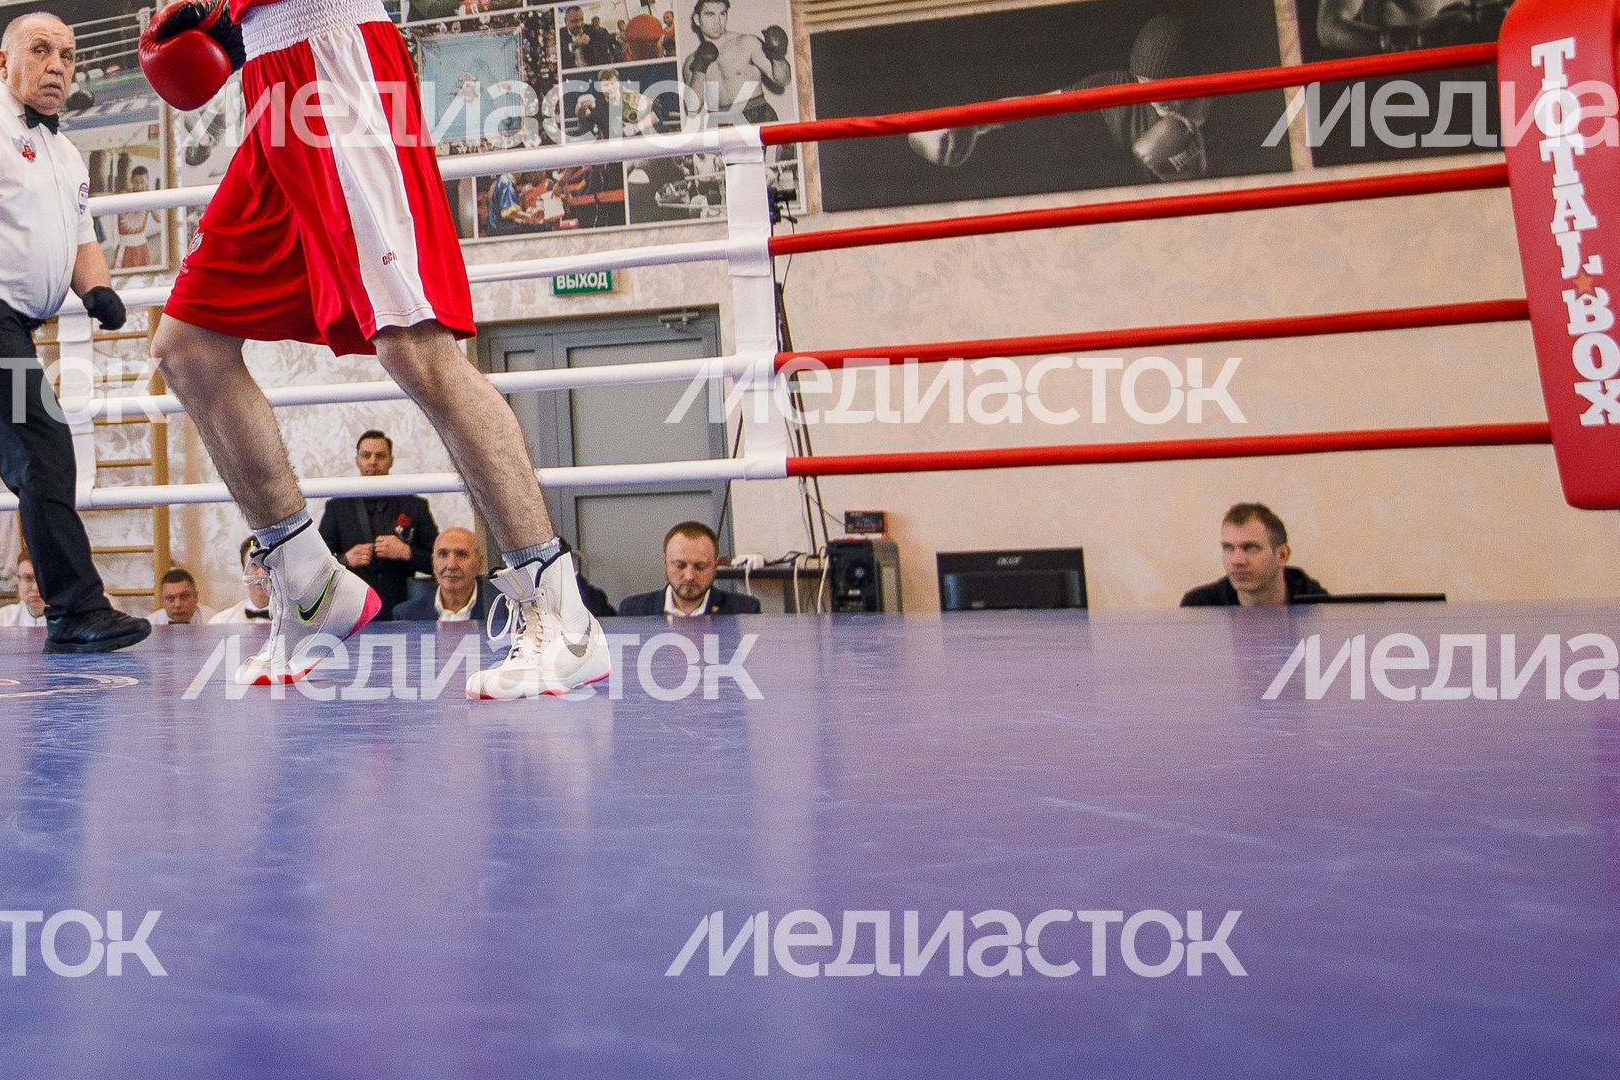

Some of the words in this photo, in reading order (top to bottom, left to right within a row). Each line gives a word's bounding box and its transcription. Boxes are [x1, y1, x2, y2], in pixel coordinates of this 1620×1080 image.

[1530, 36, 1604, 280] TOTAL
[556, 271, 608, 290] ВЫХОД
[1561, 287, 1620, 427] BOX
